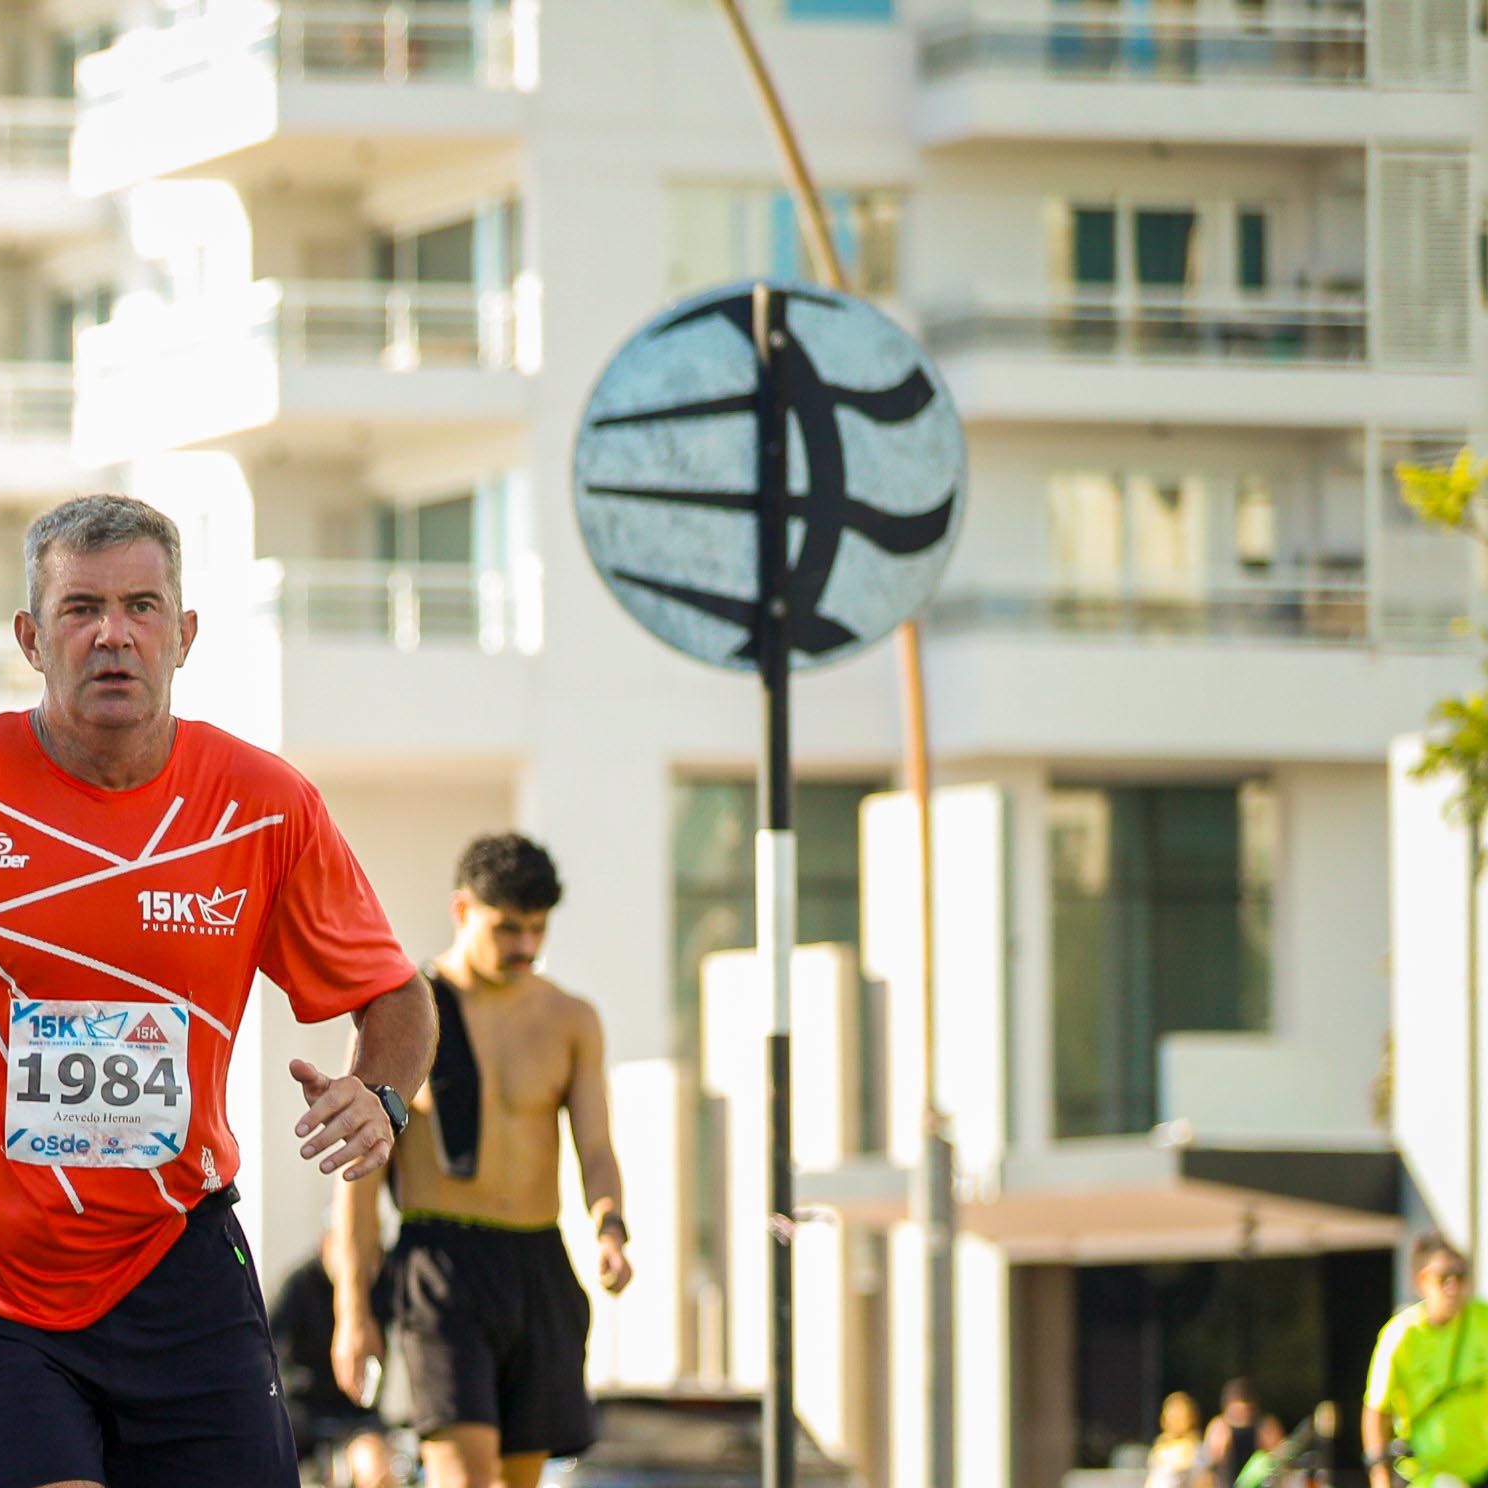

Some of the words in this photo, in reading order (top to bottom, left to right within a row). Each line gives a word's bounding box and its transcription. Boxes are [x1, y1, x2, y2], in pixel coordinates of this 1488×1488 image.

[137, 890, 195, 923] 15K
[143, 923, 195, 934] PUERTO
[199, 927, 235, 936] NORTE
[29, 1015, 79, 1038] 15K
[135, 1027, 159, 1040] 15K
[16, 1053, 182, 1107] 1984
[53, 1111, 100, 1123] Azevedo
[103, 1112, 141, 1124] Hernan
[31, 1134, 90, 1156] osde
